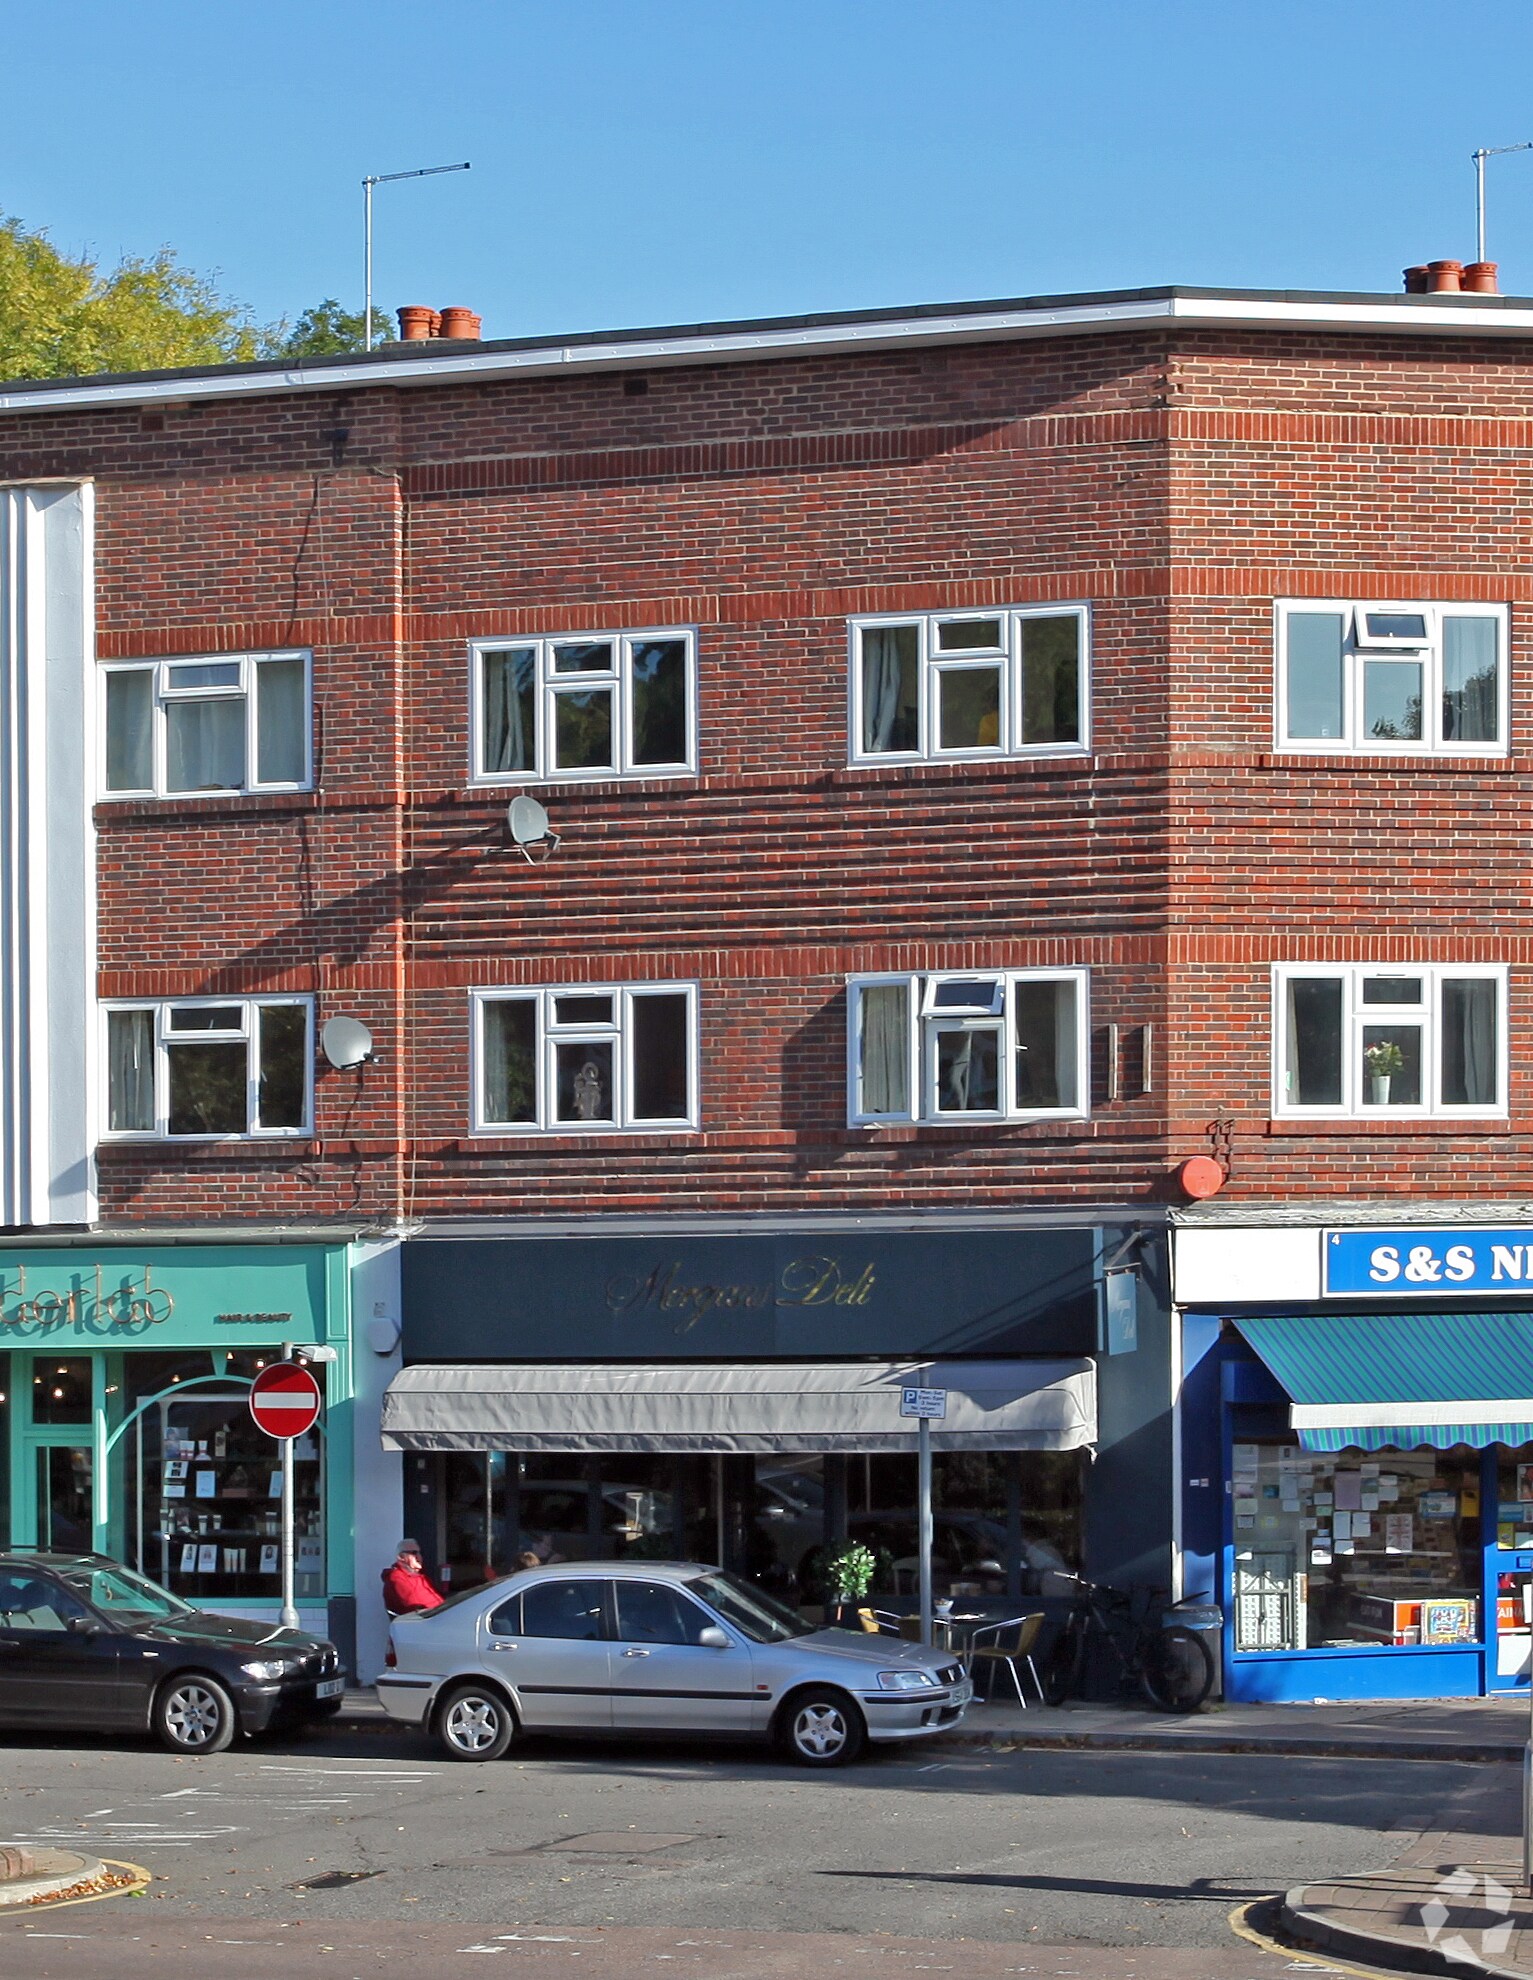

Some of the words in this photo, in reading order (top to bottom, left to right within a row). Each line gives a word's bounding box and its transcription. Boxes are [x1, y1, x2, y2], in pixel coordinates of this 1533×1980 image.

[1331, 1233, 1340, 1245] 4
[1369, 1245, 1476, 1282] S&S
[1490, 1244, 1533, 1281] N
[776, 1255, 876, 1306] Deli
[906, 1391, 916, 1403] P
